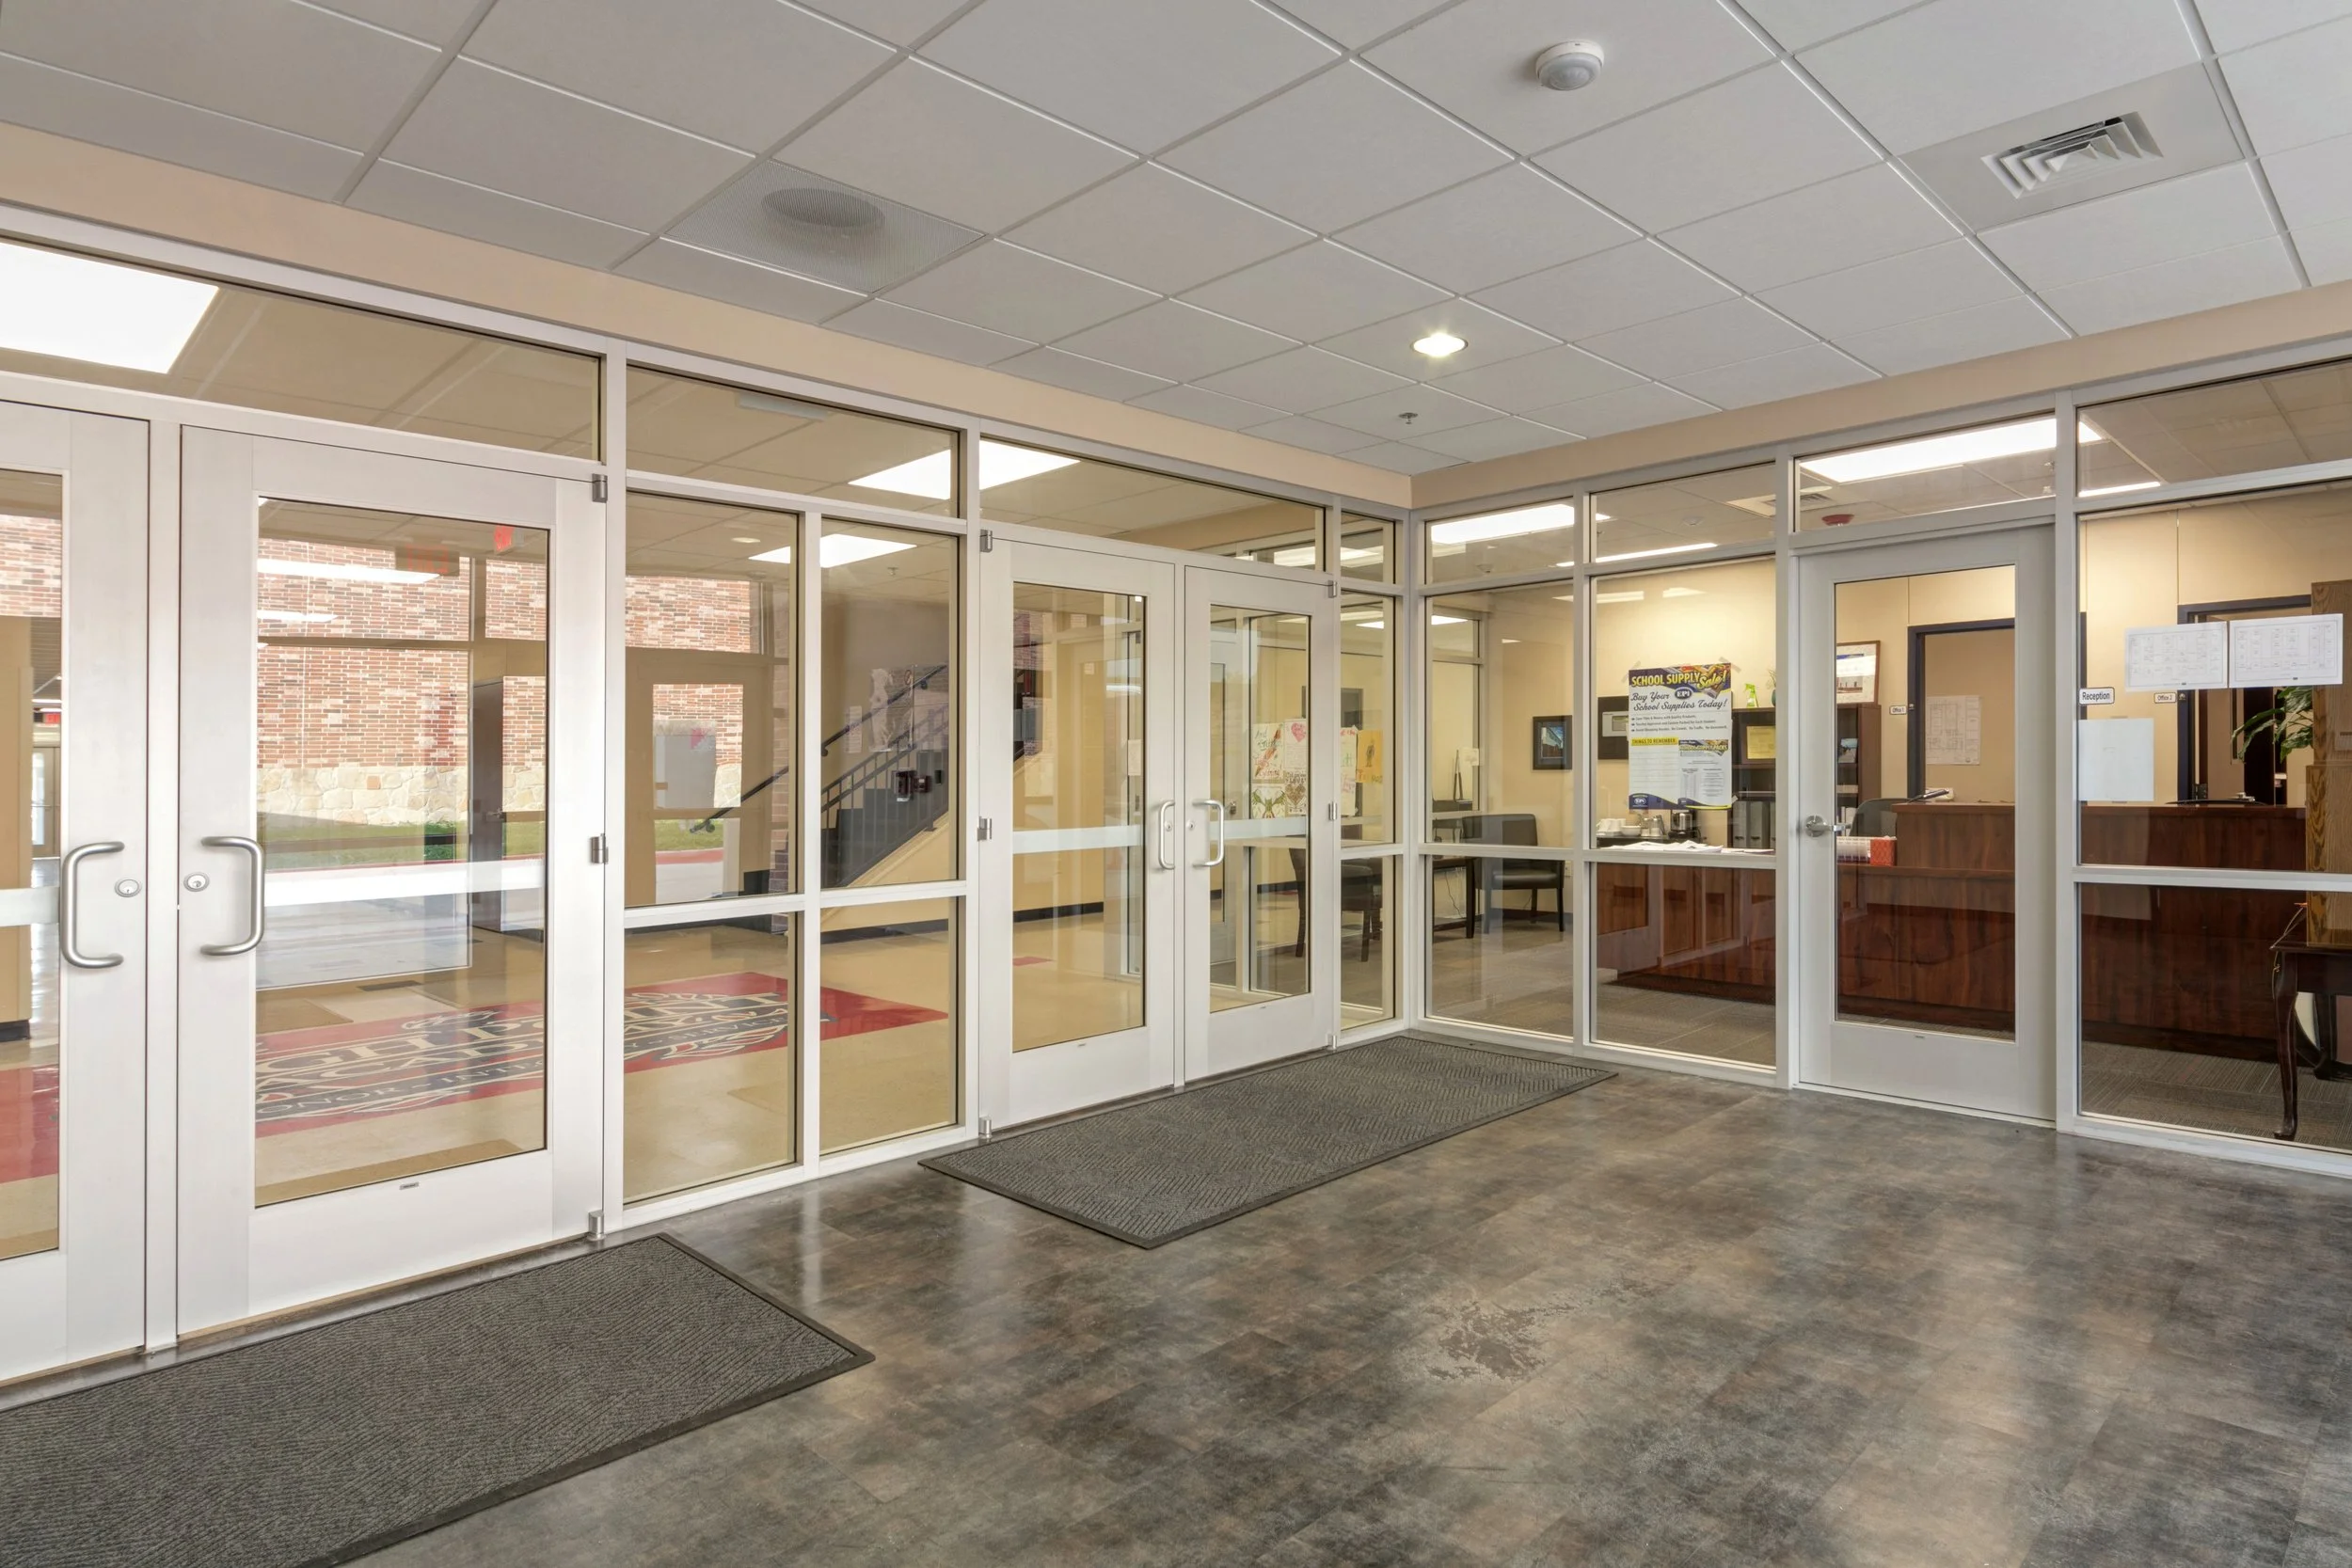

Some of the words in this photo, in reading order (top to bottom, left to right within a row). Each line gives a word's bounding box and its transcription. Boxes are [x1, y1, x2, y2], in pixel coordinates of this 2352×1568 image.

[1631, 674, 1664, 687] SCHOOL
[1666, 672, 1701, 685] SUPPLY
[1697, 670, 1727, 689] Sale!
[1630, 692, 1647, 703] Buy
[1649, 692, 1670, 702] Your
[2082, 691, 2110, 702] Reception
[1633, 703, 1660, 711] School
[1661, 701, 1694, 711] Supplies
[1697, 699, 1728, 709] Today!
[256, 1086, 403, 1115] ONOR
